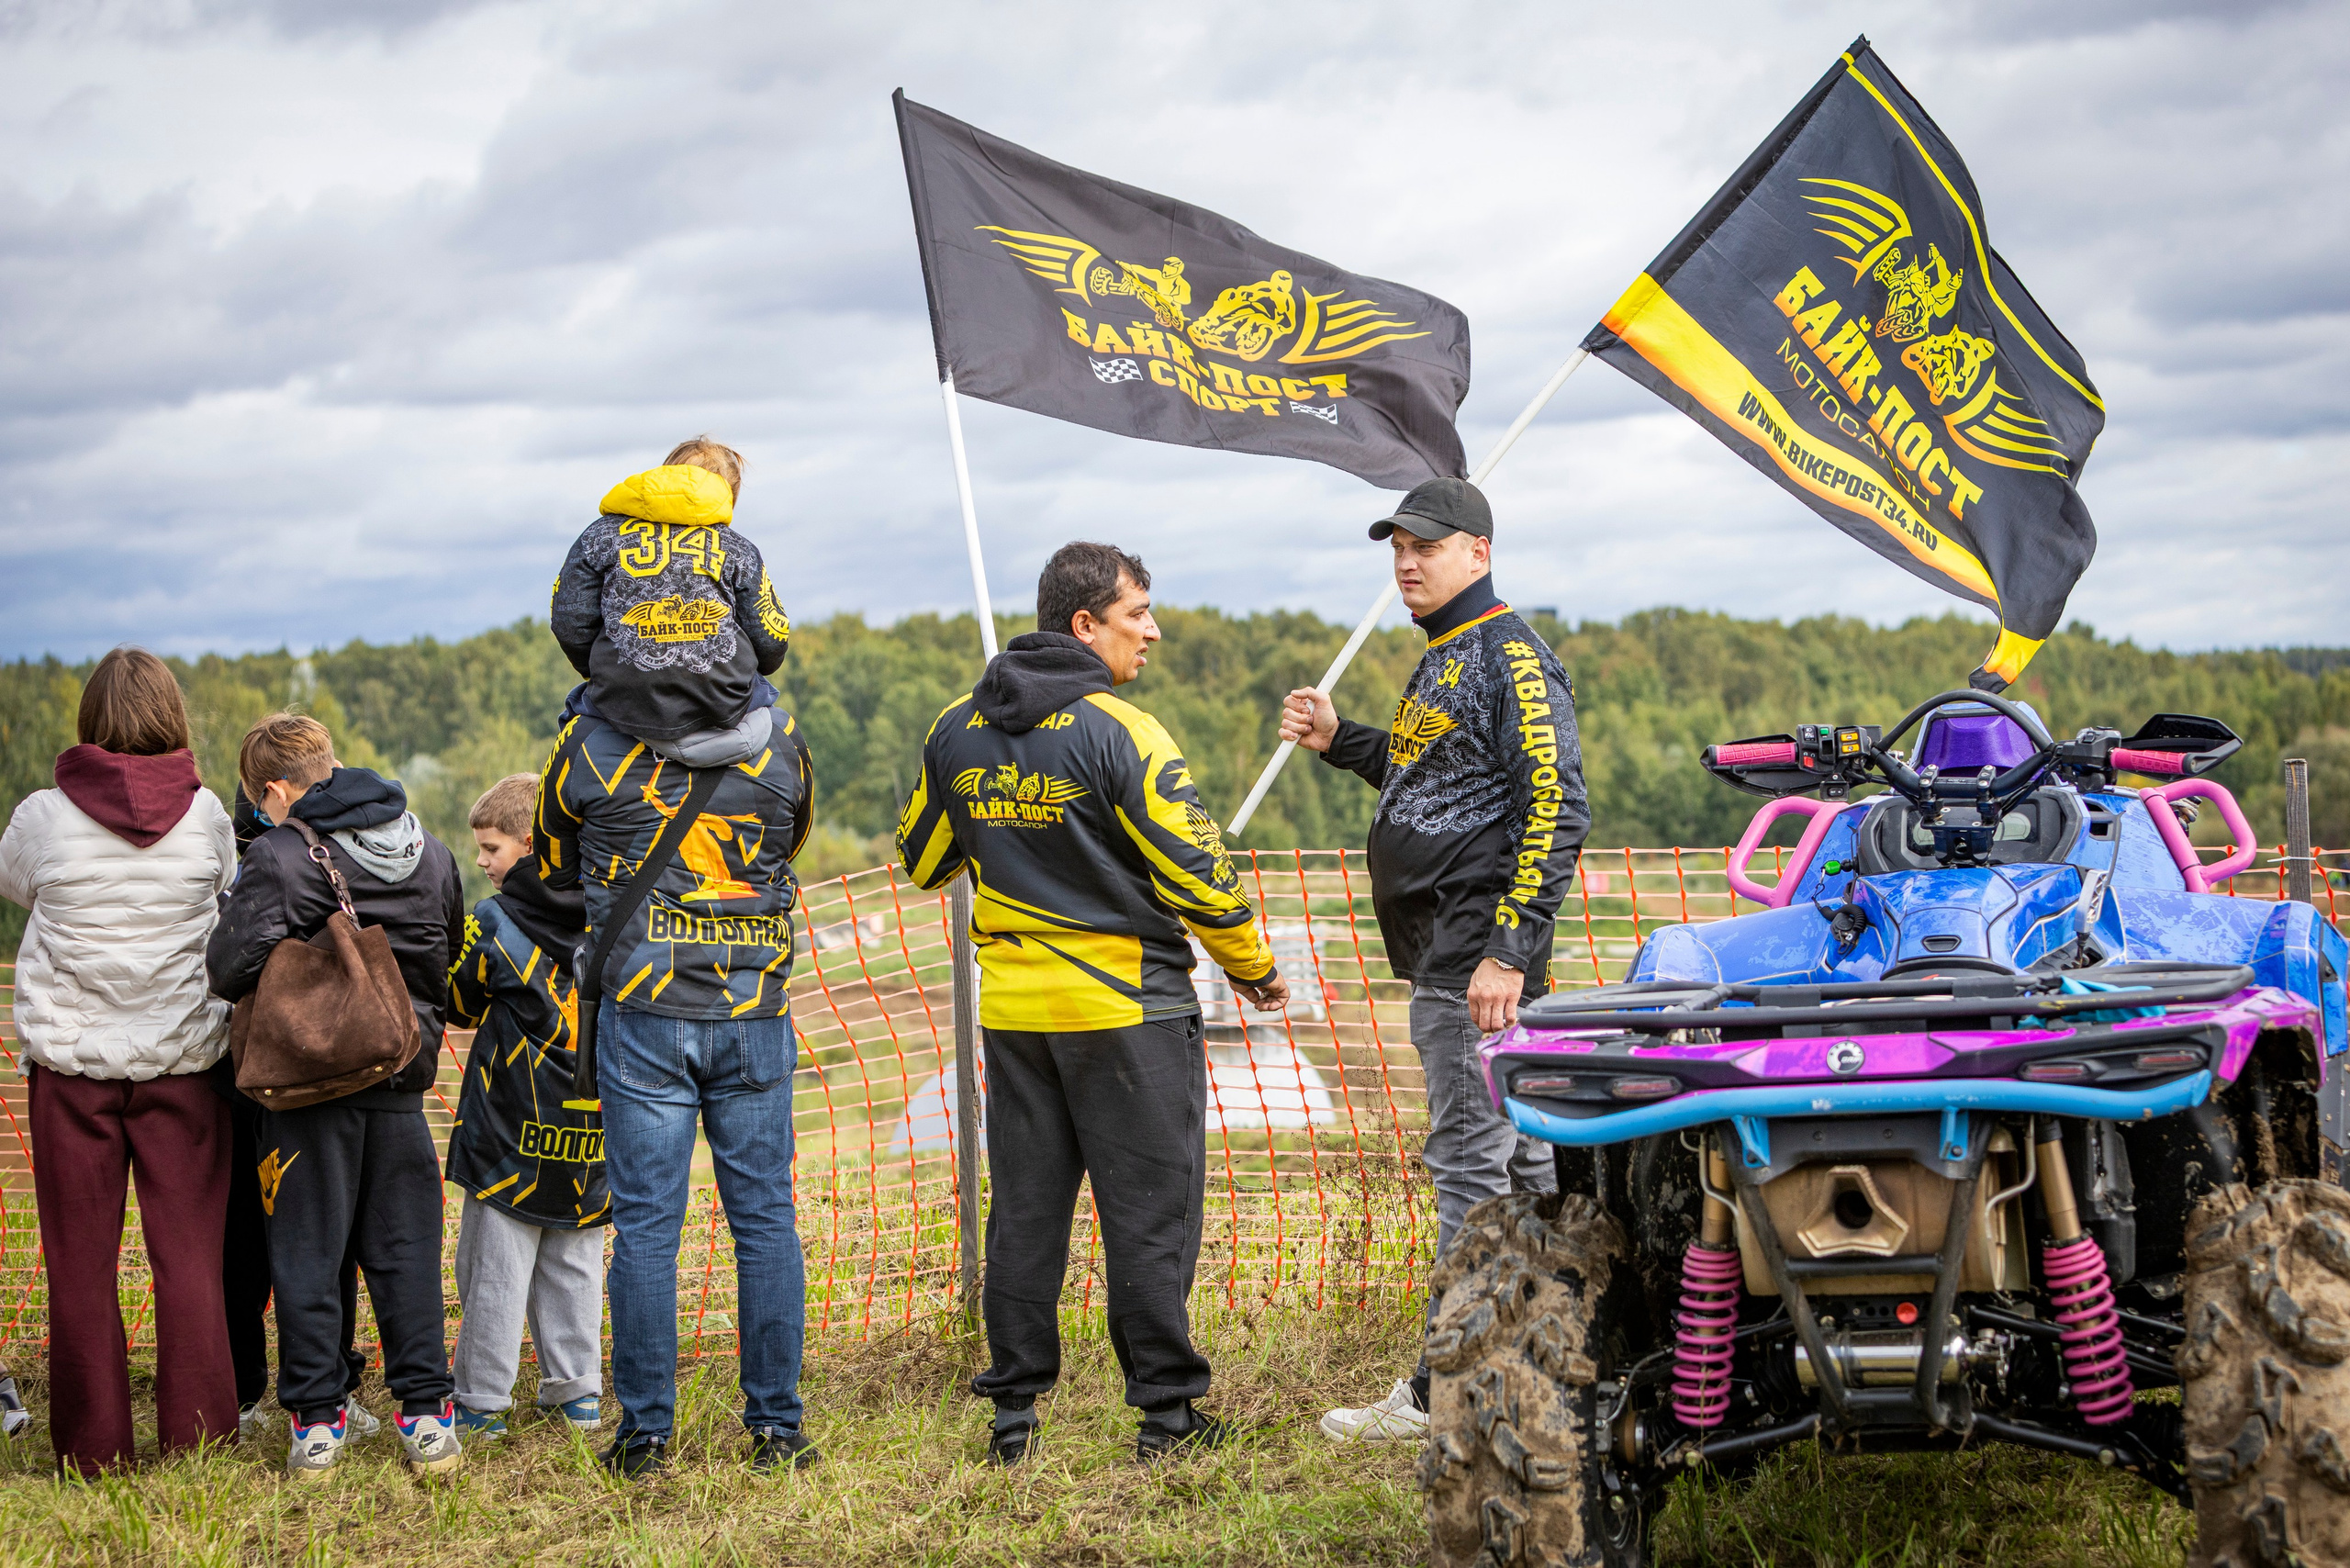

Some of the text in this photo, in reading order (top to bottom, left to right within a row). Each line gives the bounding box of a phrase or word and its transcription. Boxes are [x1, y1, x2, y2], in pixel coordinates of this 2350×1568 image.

[1061, 307, 1348, 401] БАЙК-ПОСТ
[1147, 359, 1281, 417] СПОРТ
[1773, 264, 1984, 521] БАЙК-ПОСТ
[1775, 337, 1930, 512] МОТОСАЛОН
[1737, 390, 1938, 551] WWW.BIKEPOST34.RU
[619, 518, 726, 583] 34
[640, 621, 719, 637] БАЙК-ПОСТ
[1437, 658, 1465, 689] 34
[967, 797, 1064, 823] БАЙК-ПОСТ
[987, 820, 1047, 829] МОТОСАЛОН
[257, 1148, 282, 1193] NIKE
[310, 1442, 329, 1451] NIKE
[420, 1432, 438, 1442] NIKE
